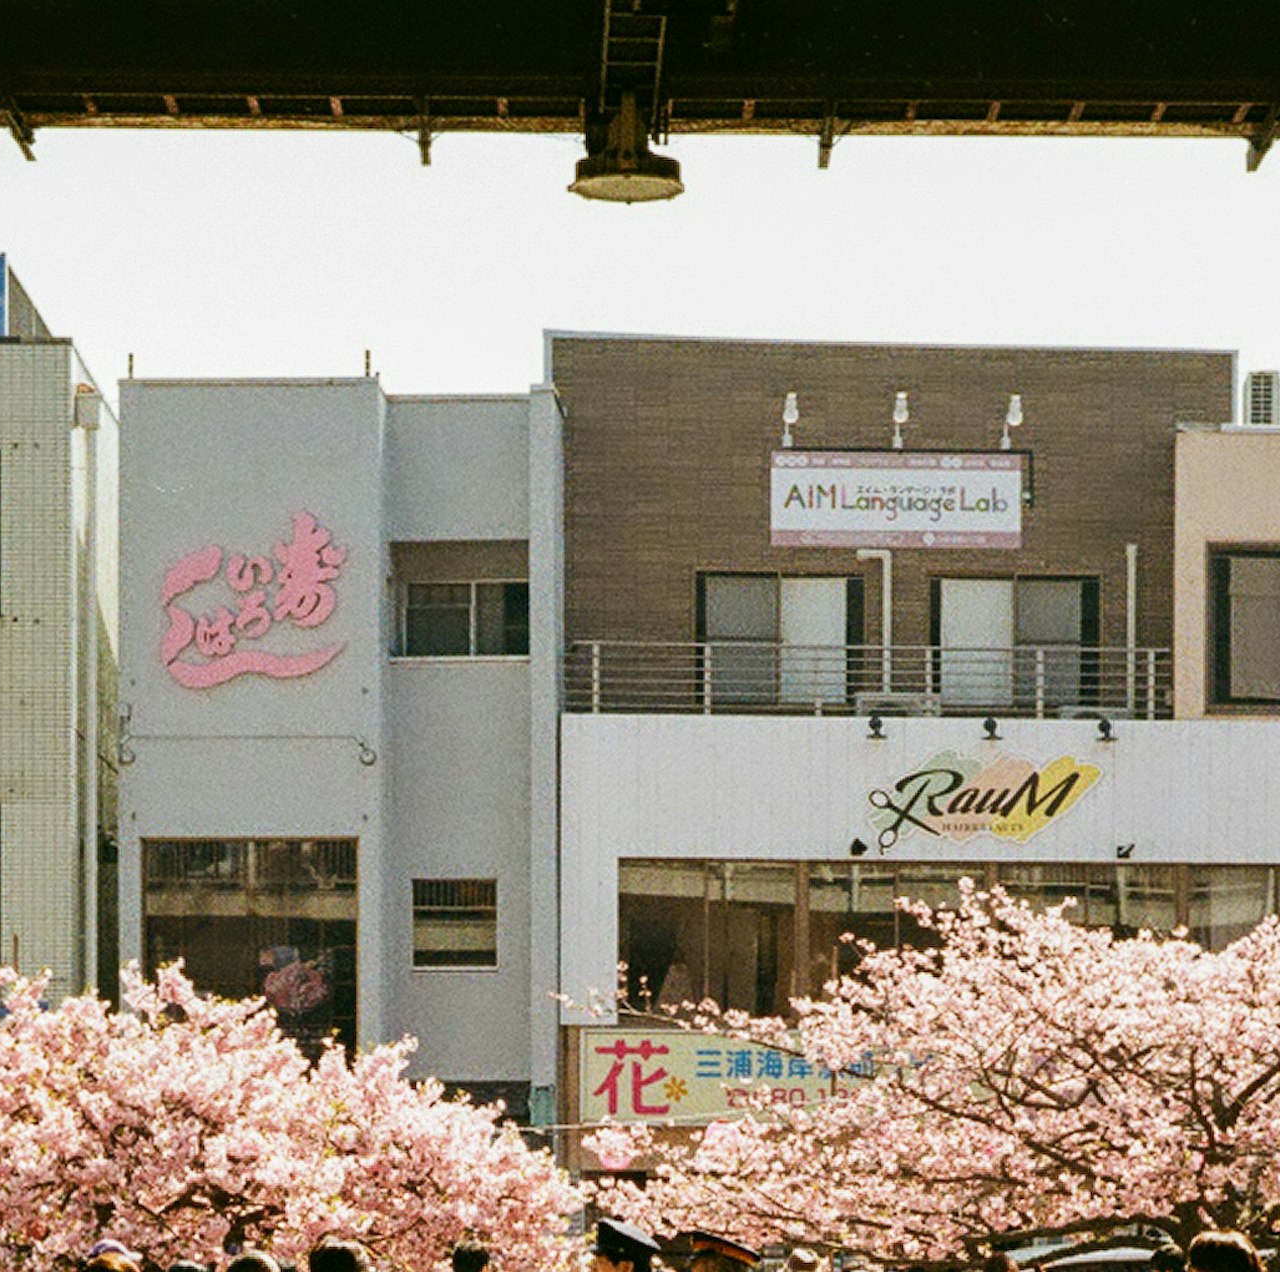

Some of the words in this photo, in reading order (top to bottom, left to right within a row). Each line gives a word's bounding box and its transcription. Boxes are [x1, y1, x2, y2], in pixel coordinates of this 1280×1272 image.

[784, 484, 836, 509] AIM
[841, 484, 955, 522] Language
[960, 485, 1009, 512] Lab
[594, 1039, 670, 1115] 花
